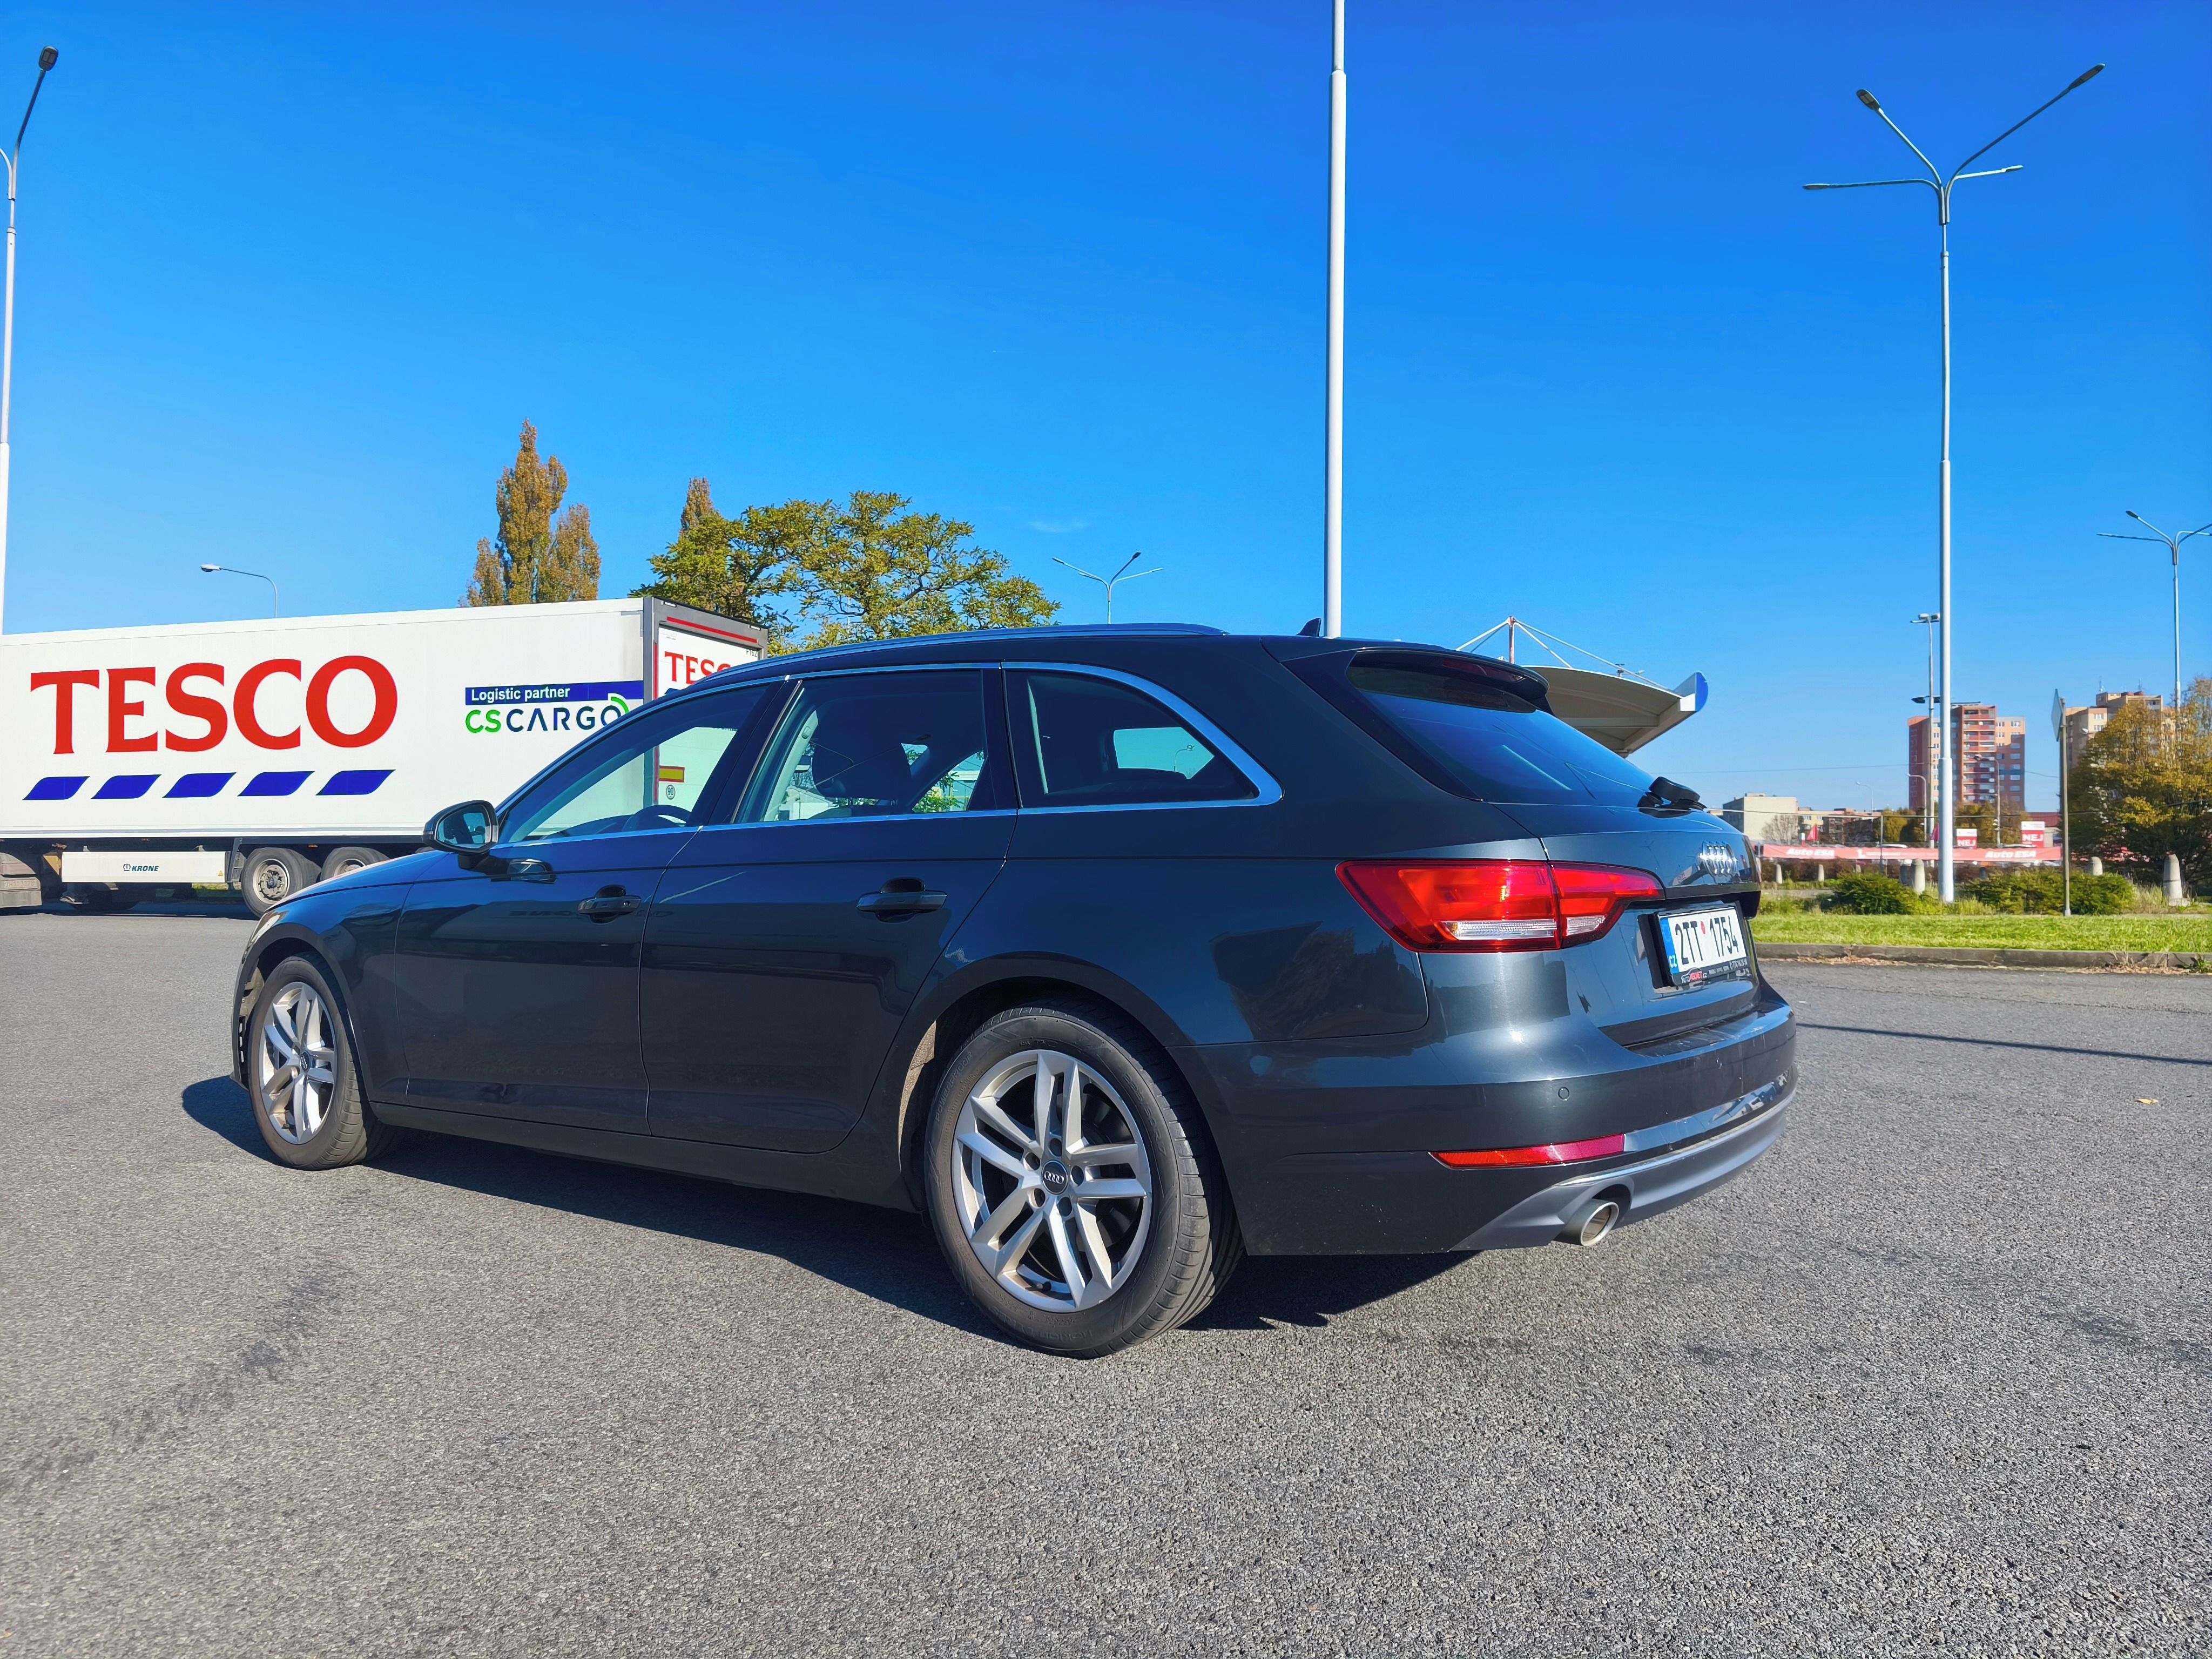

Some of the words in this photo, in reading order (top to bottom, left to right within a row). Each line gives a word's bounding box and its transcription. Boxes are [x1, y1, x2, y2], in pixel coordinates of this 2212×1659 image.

[471, 689, 521, 704] Logistic
[524, 686, 571, 702] partner
[30, 655, 397, 754] TESCO
[667, 787, 674, 795] 90
[1675, 921, 1703, 965] 2TT
[1709, 915, 1739, 957] 1754
[1669, 955, 1678, 968] CZ
